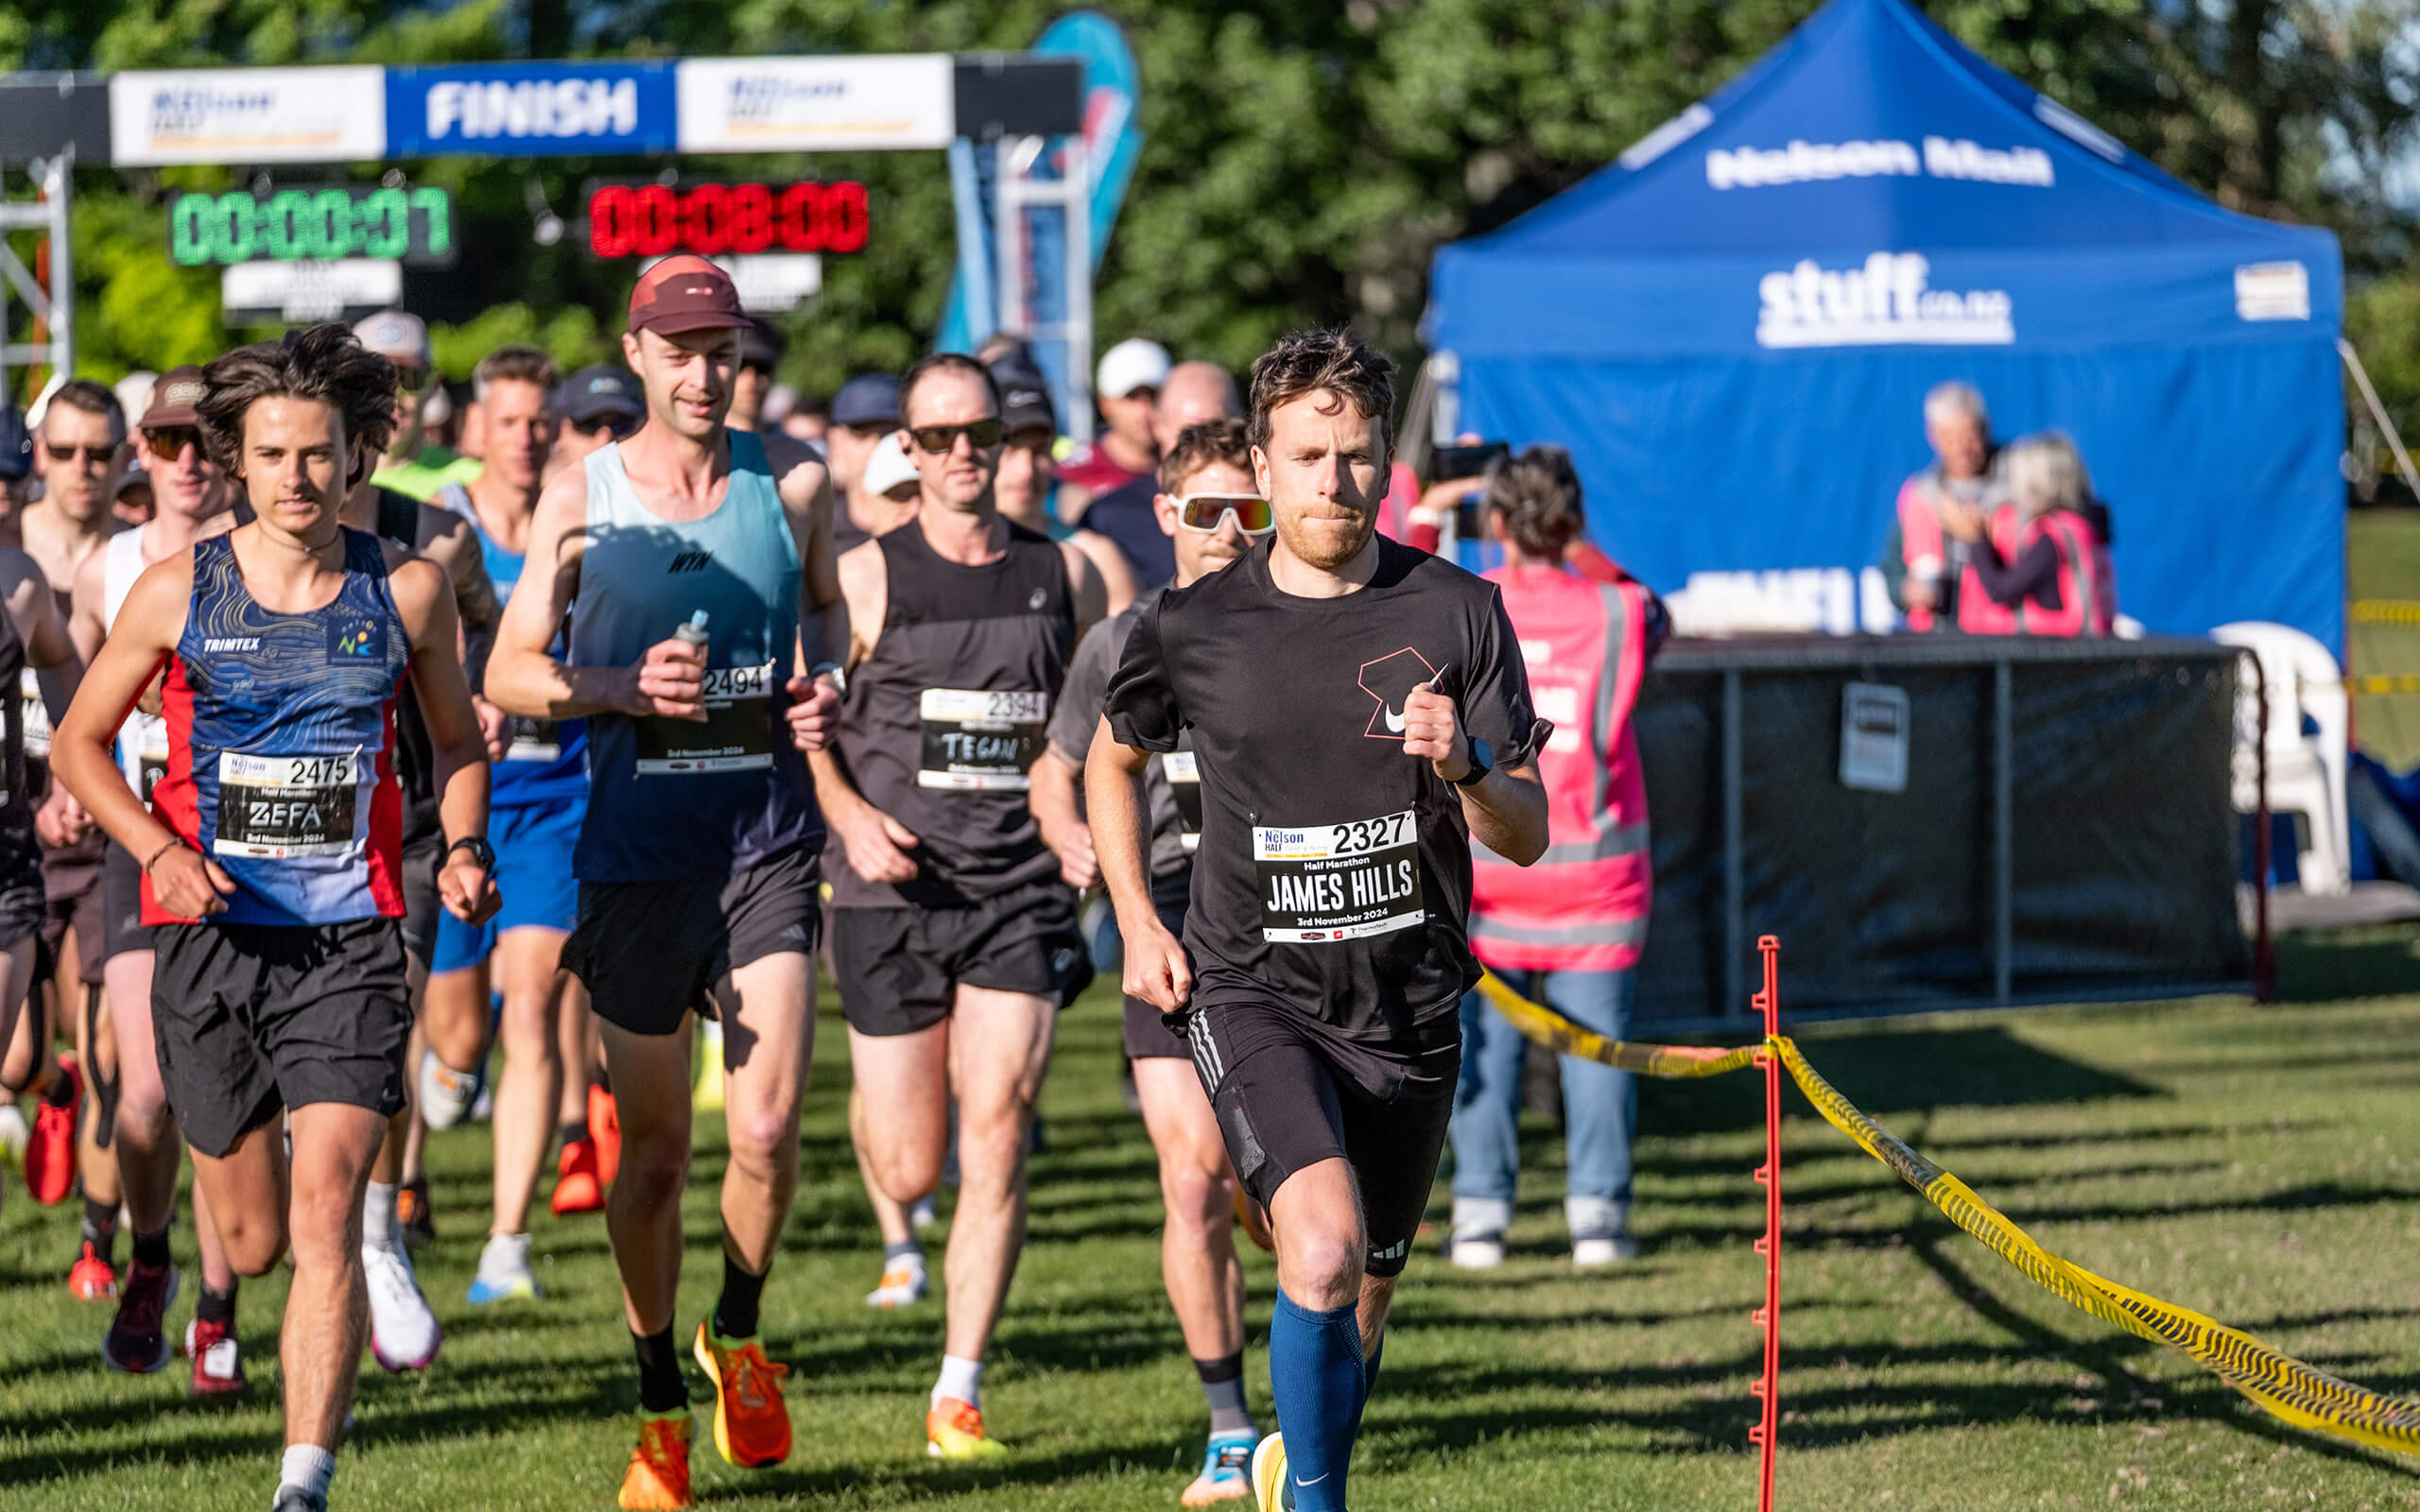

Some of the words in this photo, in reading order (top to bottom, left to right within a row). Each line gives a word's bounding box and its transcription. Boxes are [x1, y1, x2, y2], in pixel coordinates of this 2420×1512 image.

[426, 78, 638, 140] FINISH
[1706, 139, 1920, 190] Nelson
[590, 181, 869, 258] 00:08:00
[204, 638, 260, 652] TRIMTEX
[704, 668, 763, 695] 2494
[942, 732, 1019, 761] TEGAN
[291, 758, 348, 784] 2475
[250, 802, 321, 829] ZEFA
[262, 834, 302, 845] November
[1265, 830, 1304, 843] Nelson
[1333, 814, 1406, 853] 2327
[1305, 862, 1324, 870] Half
[1326, 856, 1370, 870] Marathon
[1268, 872, 1344, 912] JAMES
[1351, 859, 1412, 907] HILLS
[1297, 917, 1312, 926] 3rd
[1315, 914, 1361, 926] November
[1363, 907, 1388, 920] 2024
